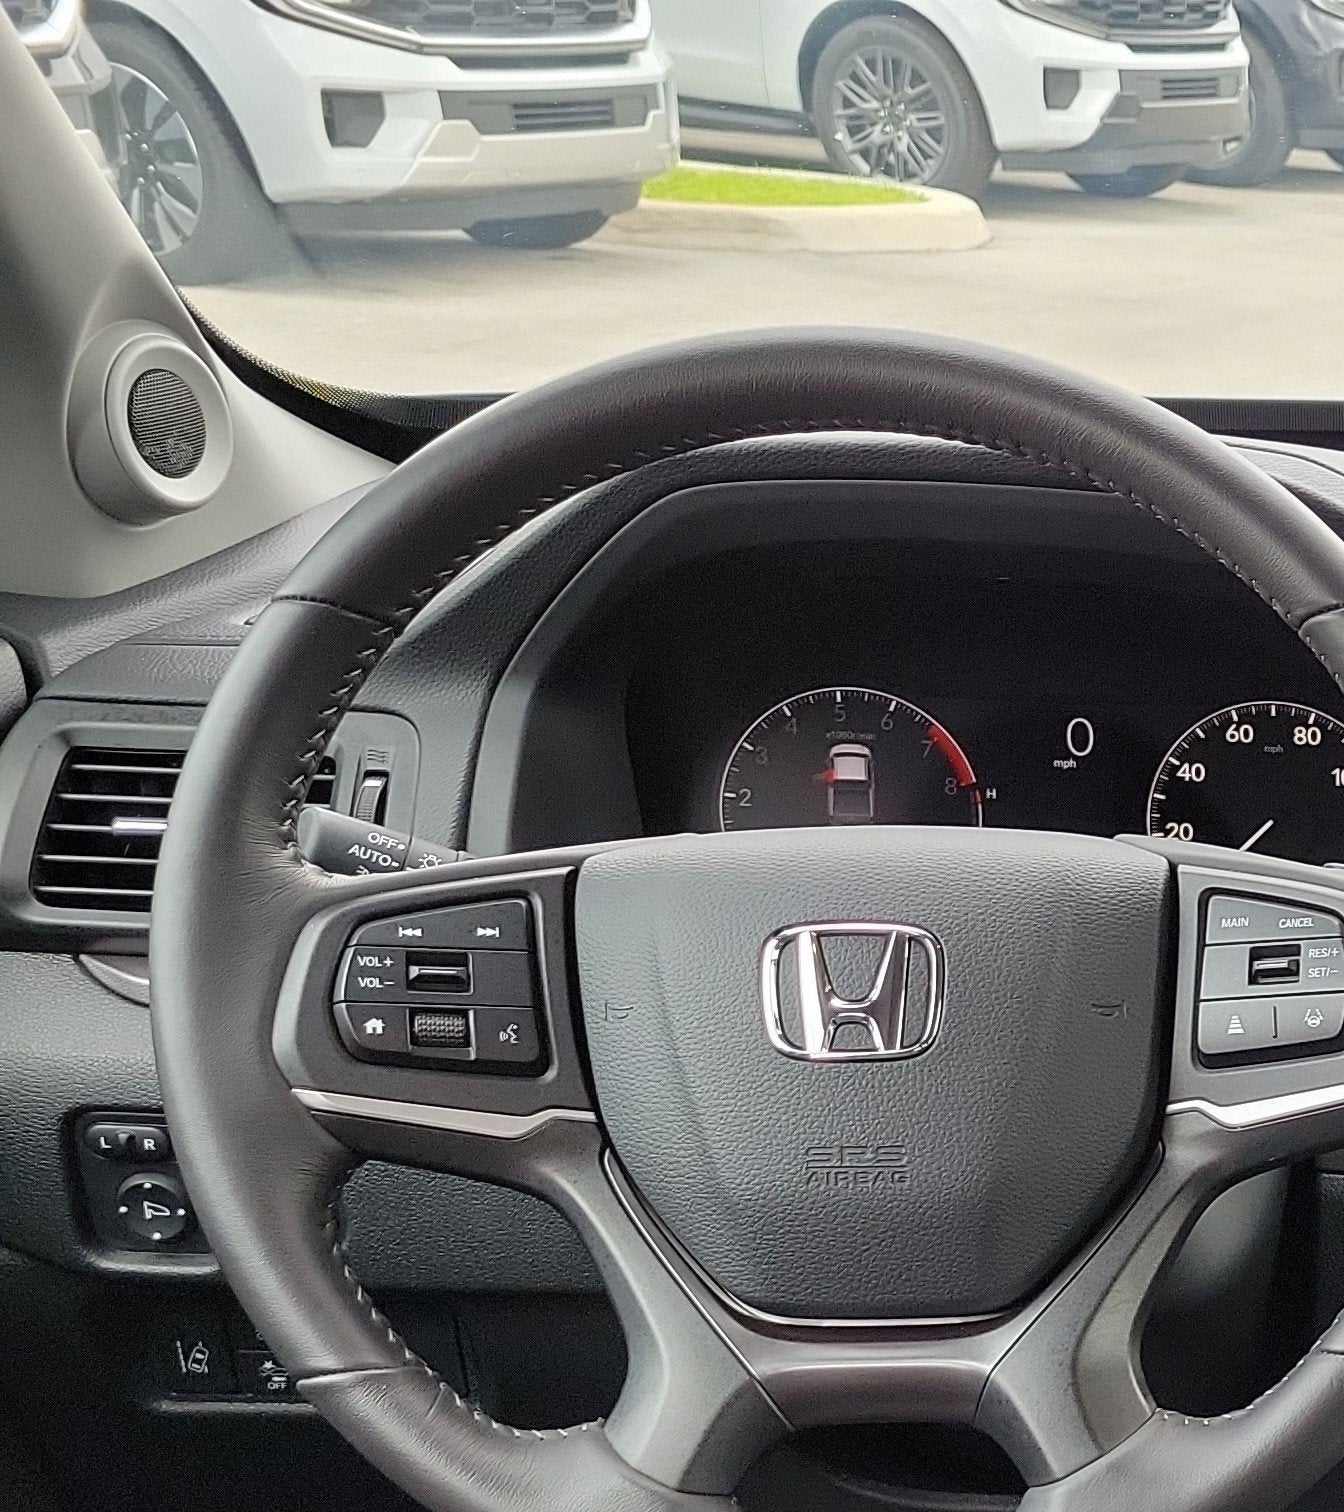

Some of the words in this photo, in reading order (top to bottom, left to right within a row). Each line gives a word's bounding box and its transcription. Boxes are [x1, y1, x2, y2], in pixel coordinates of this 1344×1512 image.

[835, 705, 846, 722] 5
[881, 713, 894, 731] 6
[786, 717, 798, 734] 4
[1226, 724, 1254, 743] 60
[1066, 718, 1094, 757] 0
[1293, 726, 1321, 746] 80
[921, 741, 932, 758] 7
[1263, 744, 1284, 753] mph
[755, 750, 768, 765] 3
[1053, 759, 1077, 769] mph
[1176, 763, 1206, 782] 40
[945, 778, 957, 795] 8
[986, 788, 997, 799] H
[739, 788, 752, 807] 2
[1164, 822, 1194, 842] 20
[367, 832, 399, 850] OFF
[348, 844, 393, 868] AUTO
[1221, 918, 1249, 928] MAIN
[1279, 917, 1314, 929] CANCEL
[100, 1136, 111, 1149] L
[143, 1138, 157, 1151] R
[804, 1144, 906, 1168] SRS
[806, 1171, 911, 1187] AIRBAG
[267, 1381, 288, 1390] OFF
